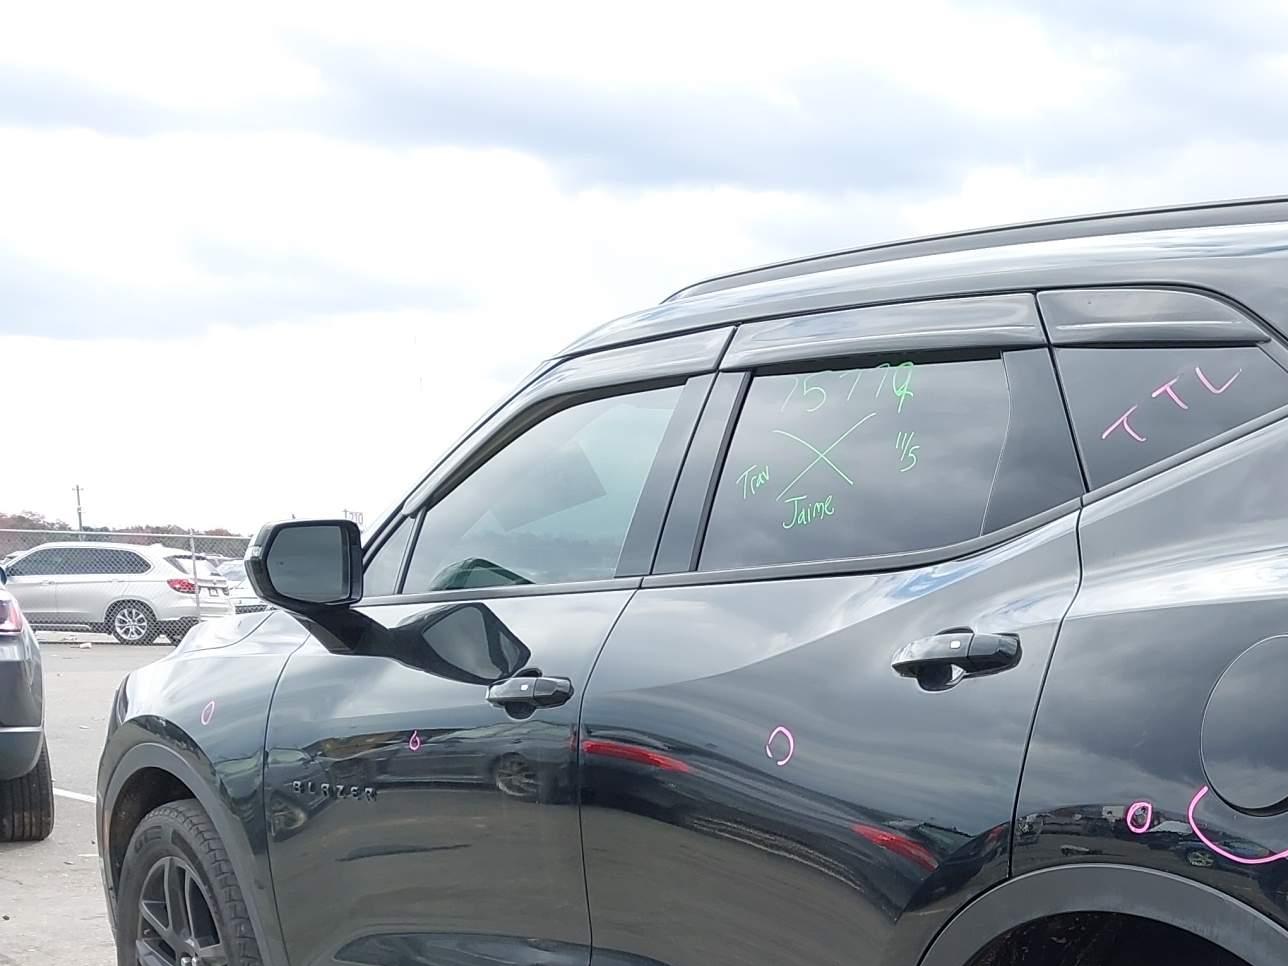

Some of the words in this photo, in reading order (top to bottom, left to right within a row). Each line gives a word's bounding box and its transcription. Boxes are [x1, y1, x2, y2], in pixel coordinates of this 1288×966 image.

[736, 465, 769, 499] Trav
[783, 495, 834, 528] Jaime
[293, 781, 375, 803] BLAZER
